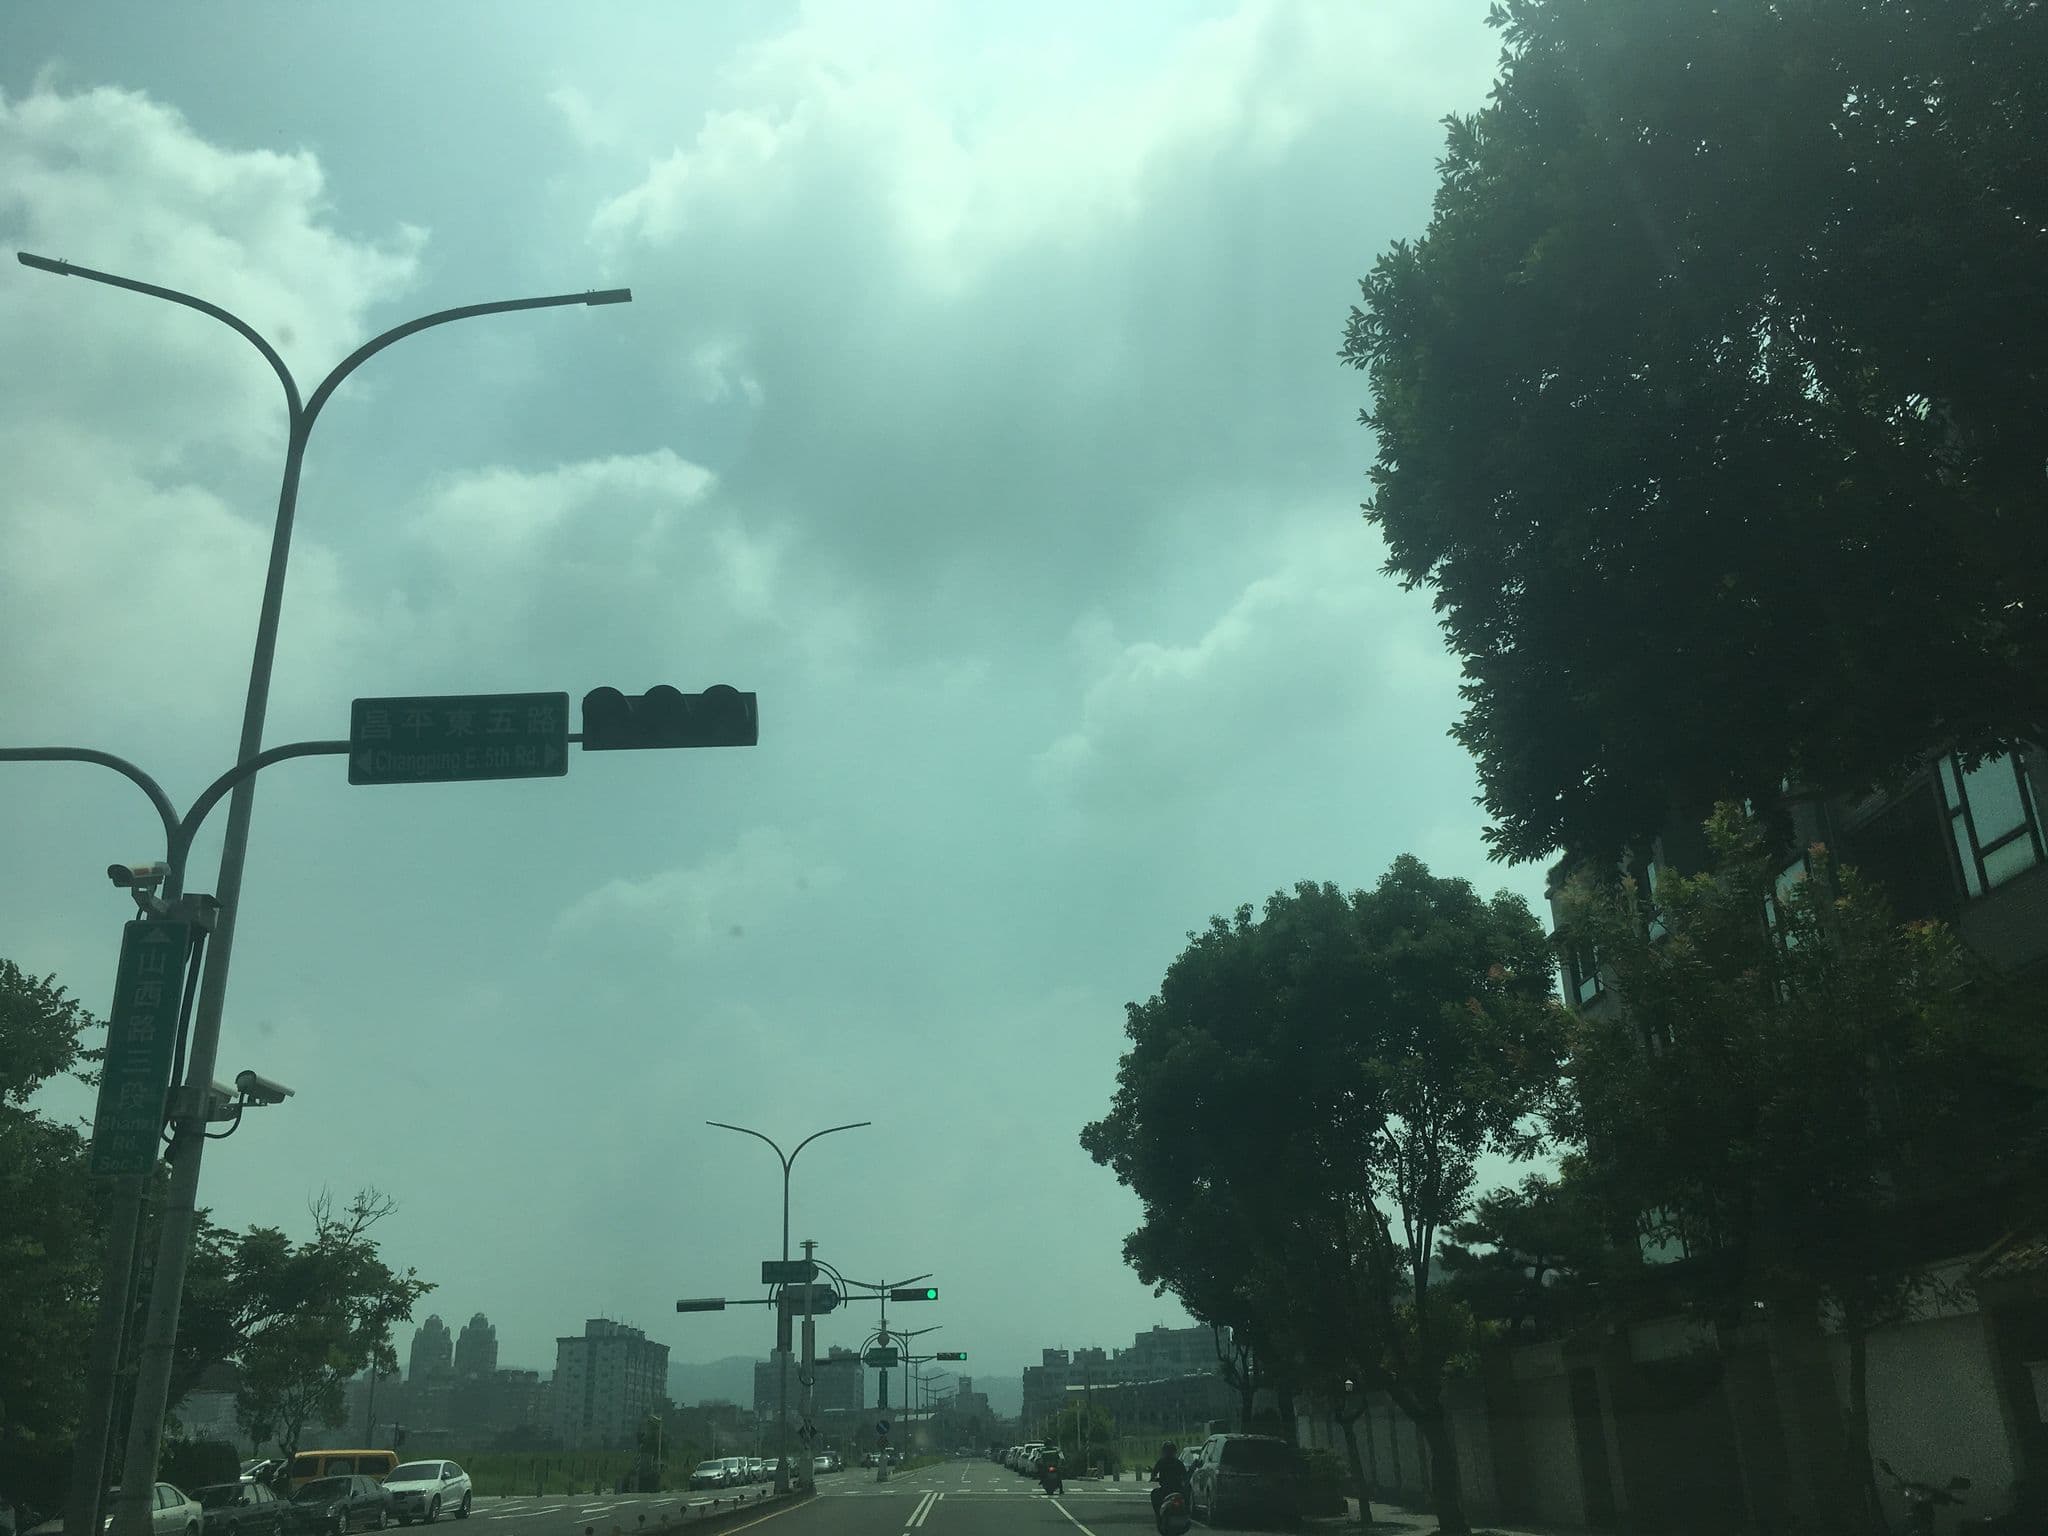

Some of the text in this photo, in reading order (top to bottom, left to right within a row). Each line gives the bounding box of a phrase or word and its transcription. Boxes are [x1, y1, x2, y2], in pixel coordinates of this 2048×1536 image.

[361, 706, 556, 741] 昌平東五路
[486, 745, 512, 768] 5th
[119, 946, 168, 1110] 山西路三段
